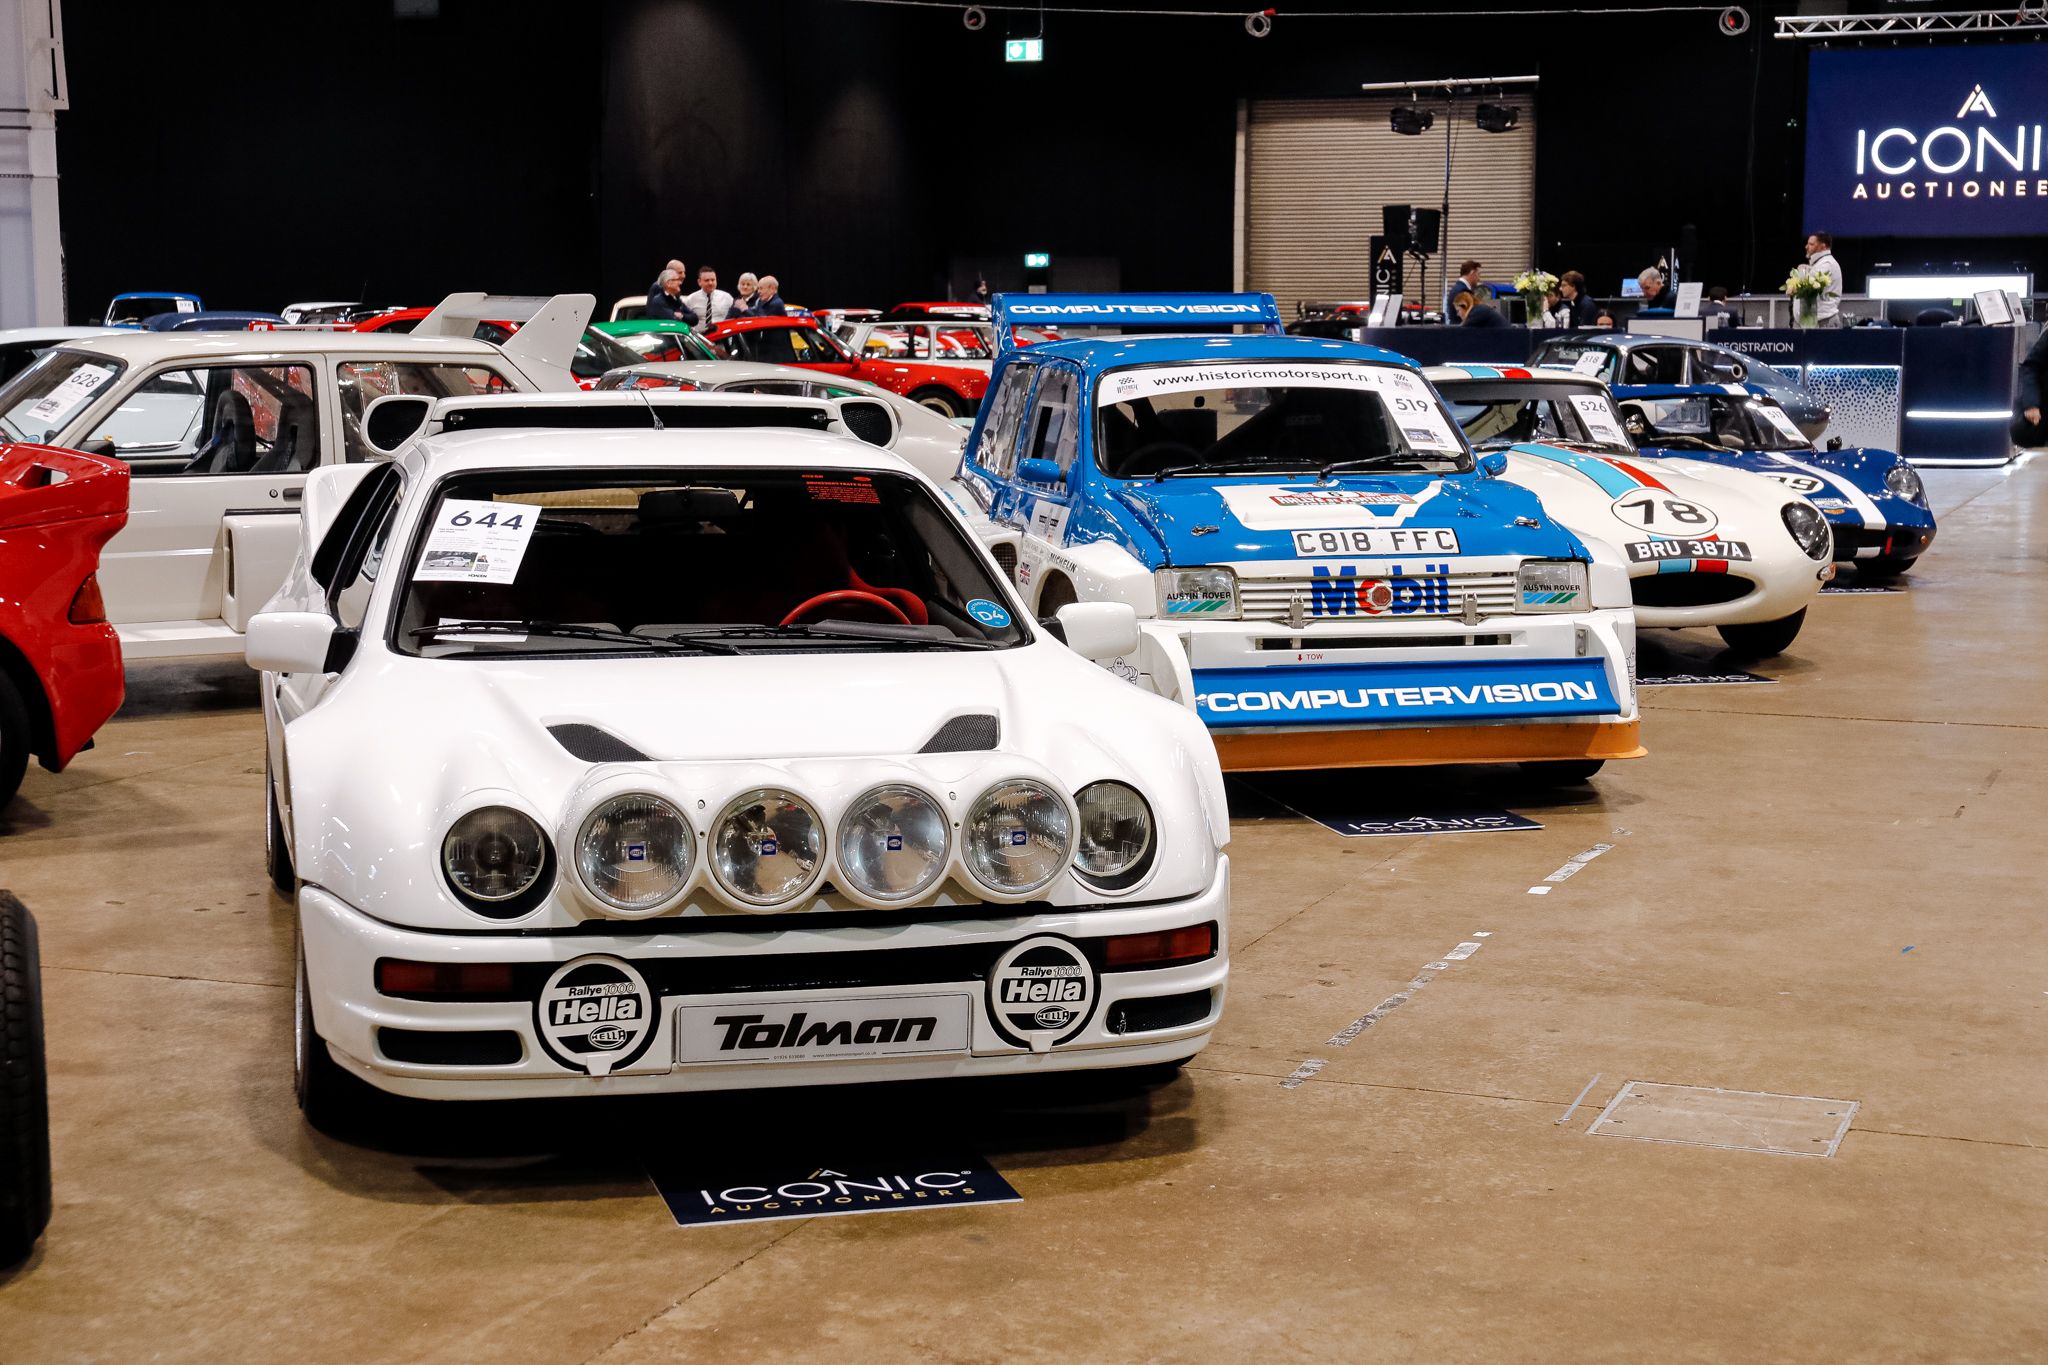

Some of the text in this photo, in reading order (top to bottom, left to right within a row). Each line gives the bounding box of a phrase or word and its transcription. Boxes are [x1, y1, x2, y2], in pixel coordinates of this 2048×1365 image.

[1856, 124, 2048, 175] ICONI
[1009, 304, 1260, 315] COMPUTERVISION
[71, 370, 100, 388] 628
[1152, 369, 1384, 387] www.historicmotorsport.nt
[1395, 398, 1429, 413] 519
[1580, 400, 1608, 413] 526
[450, 510, 524, 531] 644
[1621, 499, 1707, 525] 78
[1296, 530, 1454, 553] C818 FFC
[1634, 541, 1744, 560] BRU 387A
[1050, 552, 1078, 571] MICHELIN
[1166, 591, 1231, 600] AUSTIN ROVER
[1522, 584, 1581, 592] AUSTIN ROVER
[977, 609, 1004, 621] D4
[1208, 681, 1597, 713] COMPUTERVISION
[1348, 816, 1507, 830] ICONIC
[1021, 965, 1083, 978] Rallye 1000
[568, 982, 636, 997] Rallye 1000
[1005, 979, 1082, 1002] Hella
[554, 996, 637, 1025] Hella
[1038, 1010, 1070, 1021] HELLA
[591, 1029, 626, 1041] HELLA
[713, 1012, 937, 1051] Tolman
[710, 1187, 976, 1215] AUCTIONEERS
